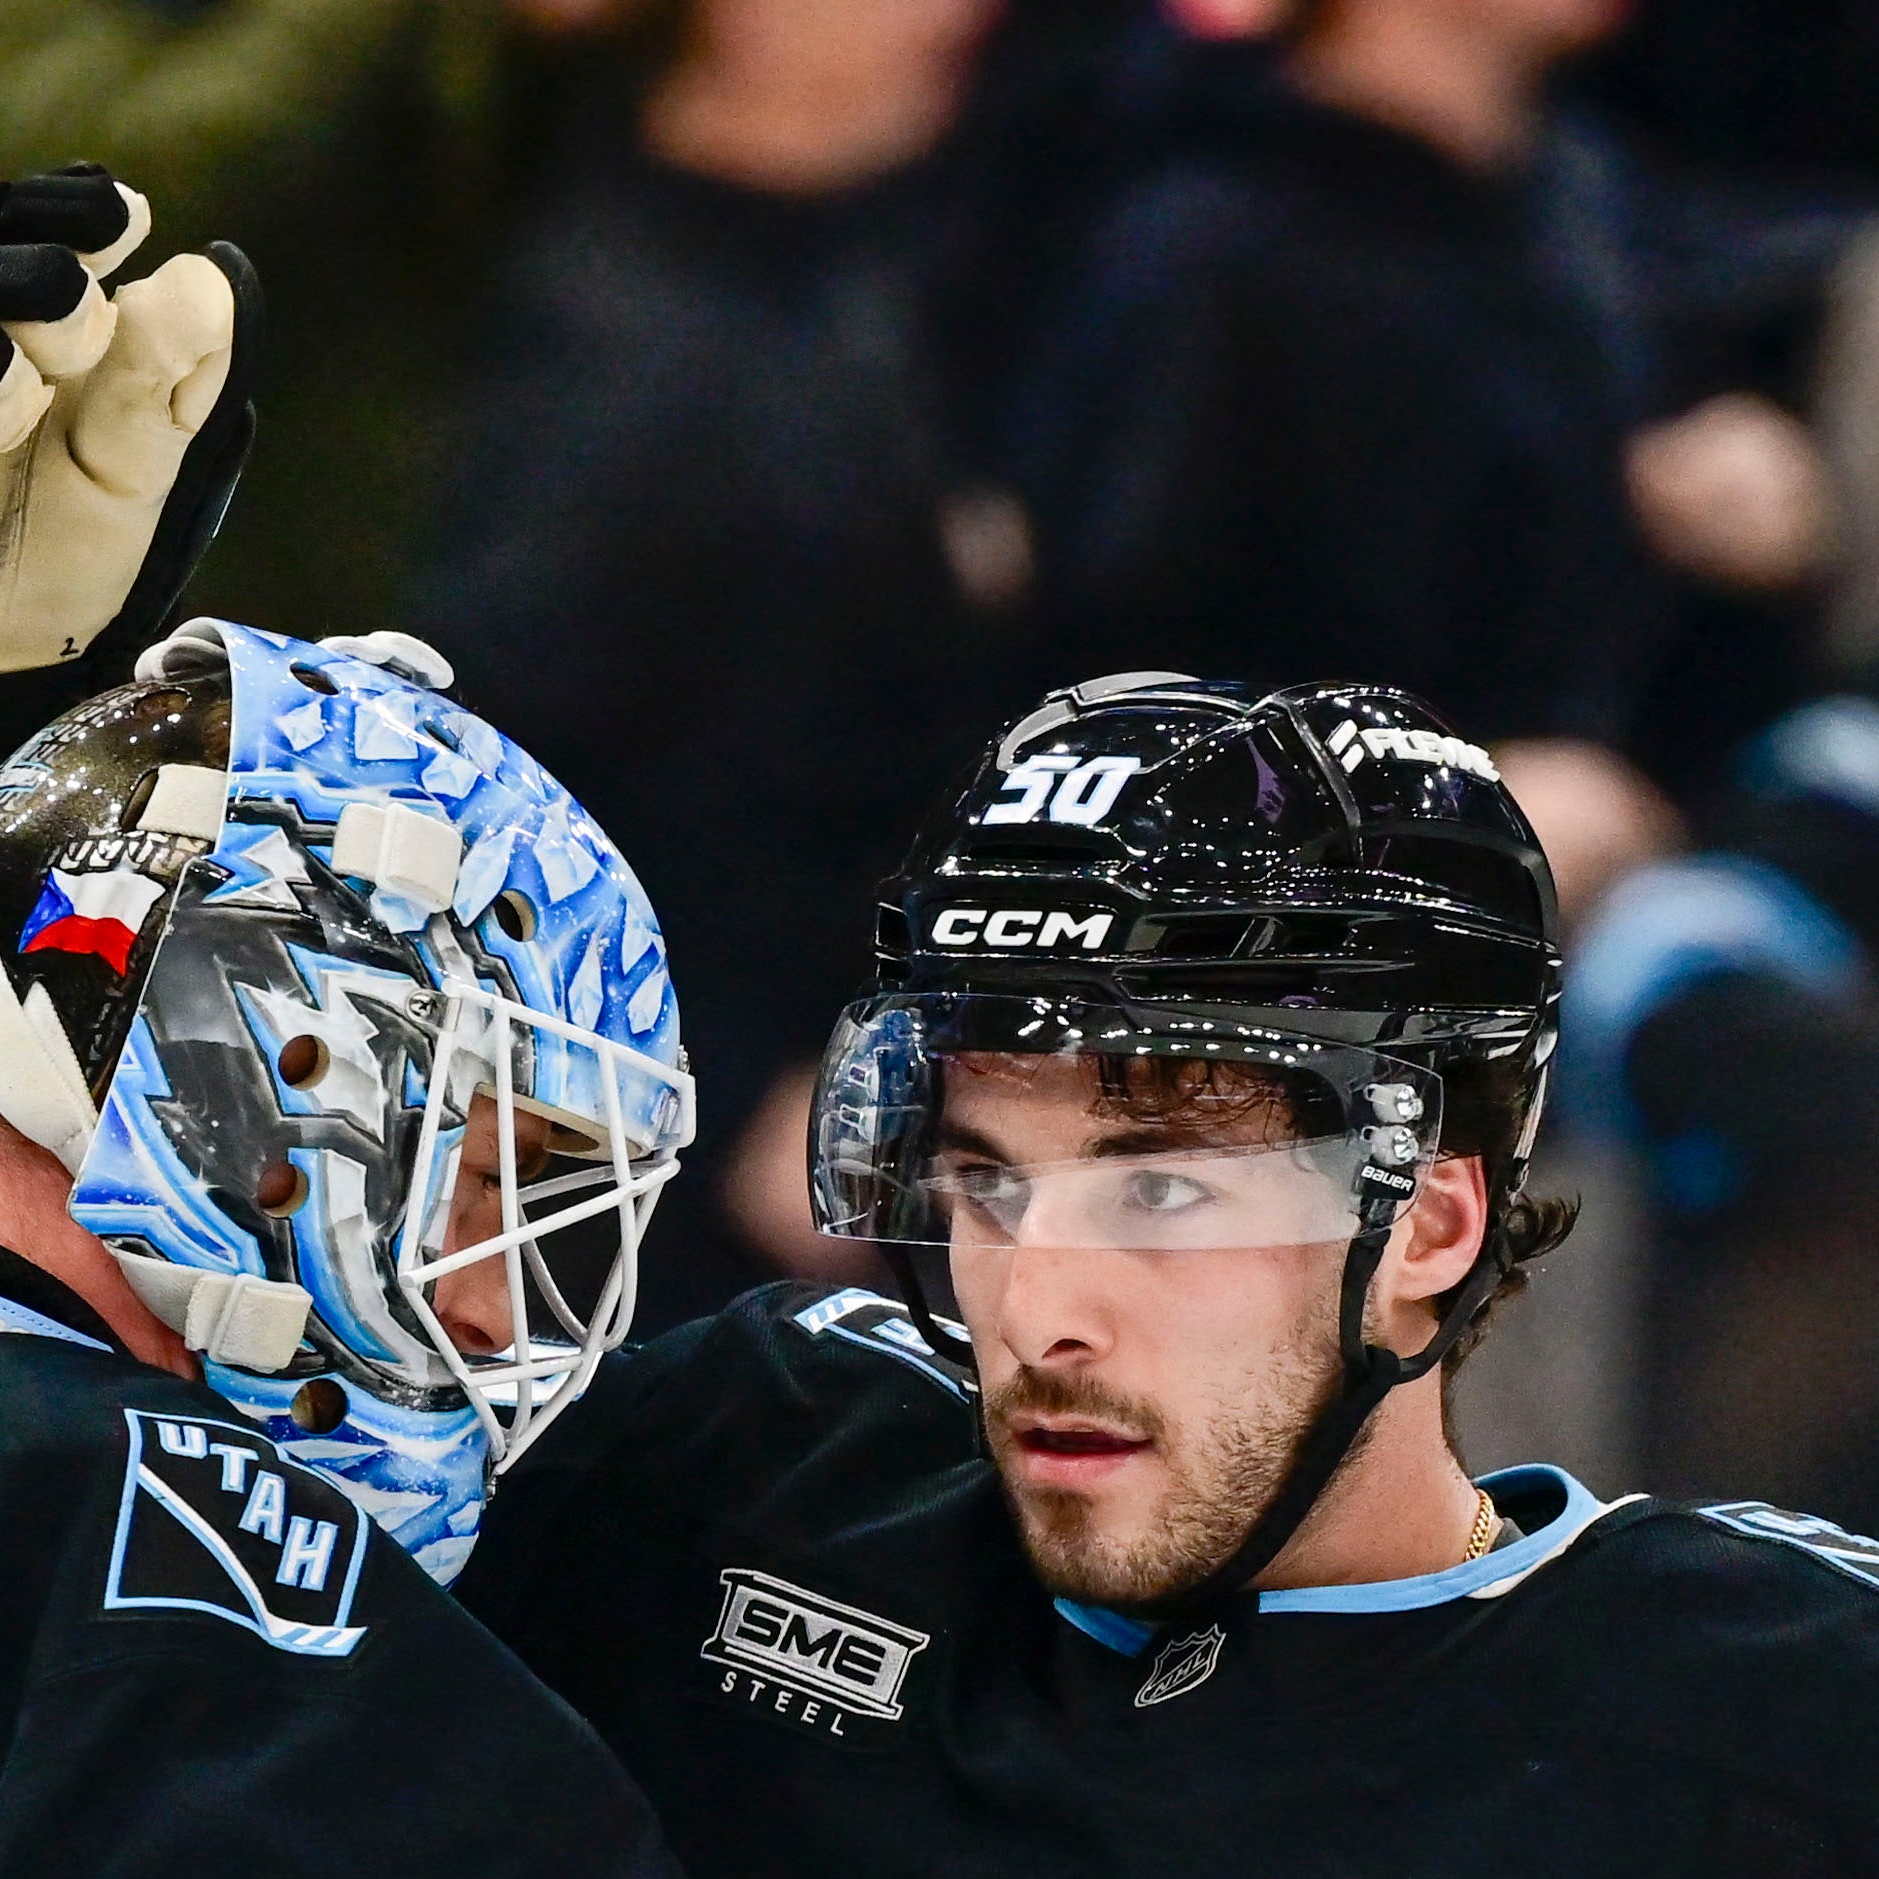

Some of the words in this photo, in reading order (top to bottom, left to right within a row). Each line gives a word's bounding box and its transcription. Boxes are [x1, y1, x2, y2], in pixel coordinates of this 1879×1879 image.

[982, 755, 1141, 825] 50
[931, 909, 1114, 949] CCM
[154, 1420, 341, 1592] UTAH
[735, 1598, 887, 1686] SME
[1149, 1652, 1206, 1699] NHL
[721, 1671, 844, 1736] STEEL
